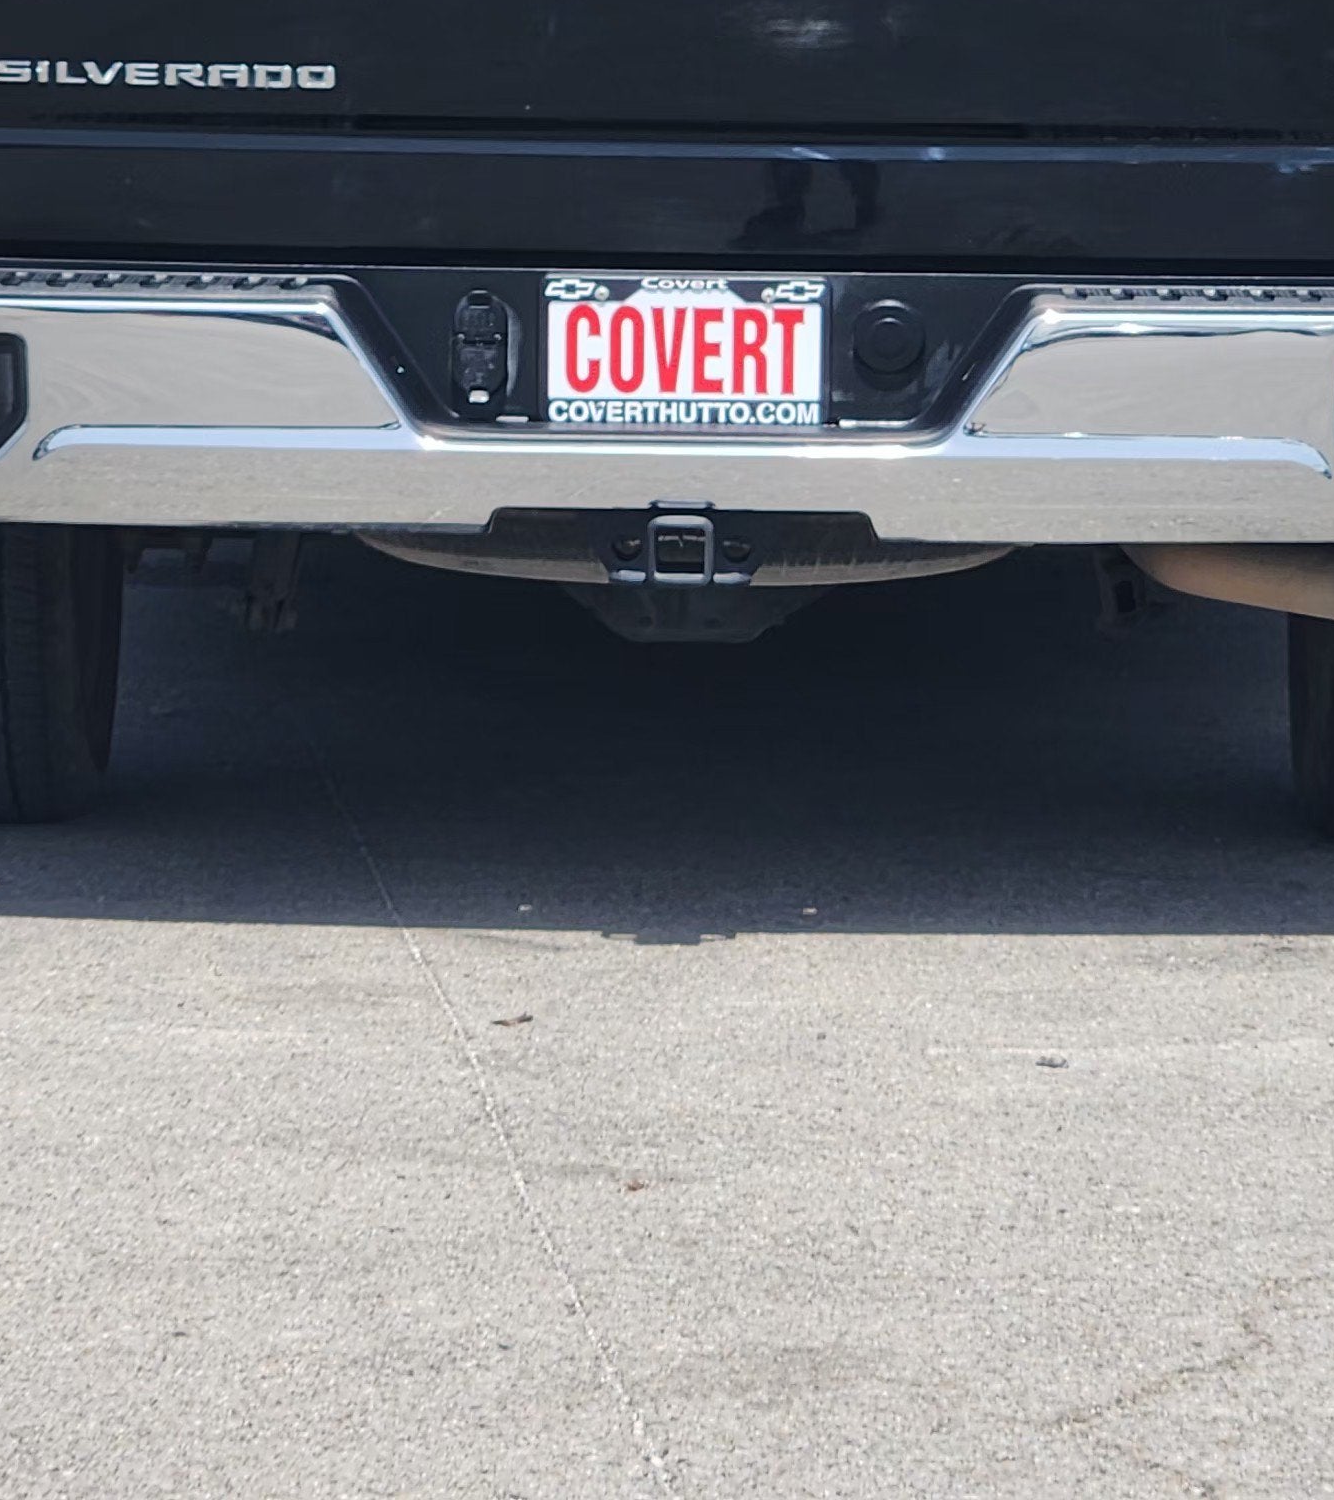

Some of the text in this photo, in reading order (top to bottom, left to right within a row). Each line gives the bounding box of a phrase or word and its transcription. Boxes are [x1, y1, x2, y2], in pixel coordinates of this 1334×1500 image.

[640, 276, 729, 290] Covert
[565, 304, 805, 395] COVERT
[548, 400, 820, 424] COVERTHUTTO.COM
